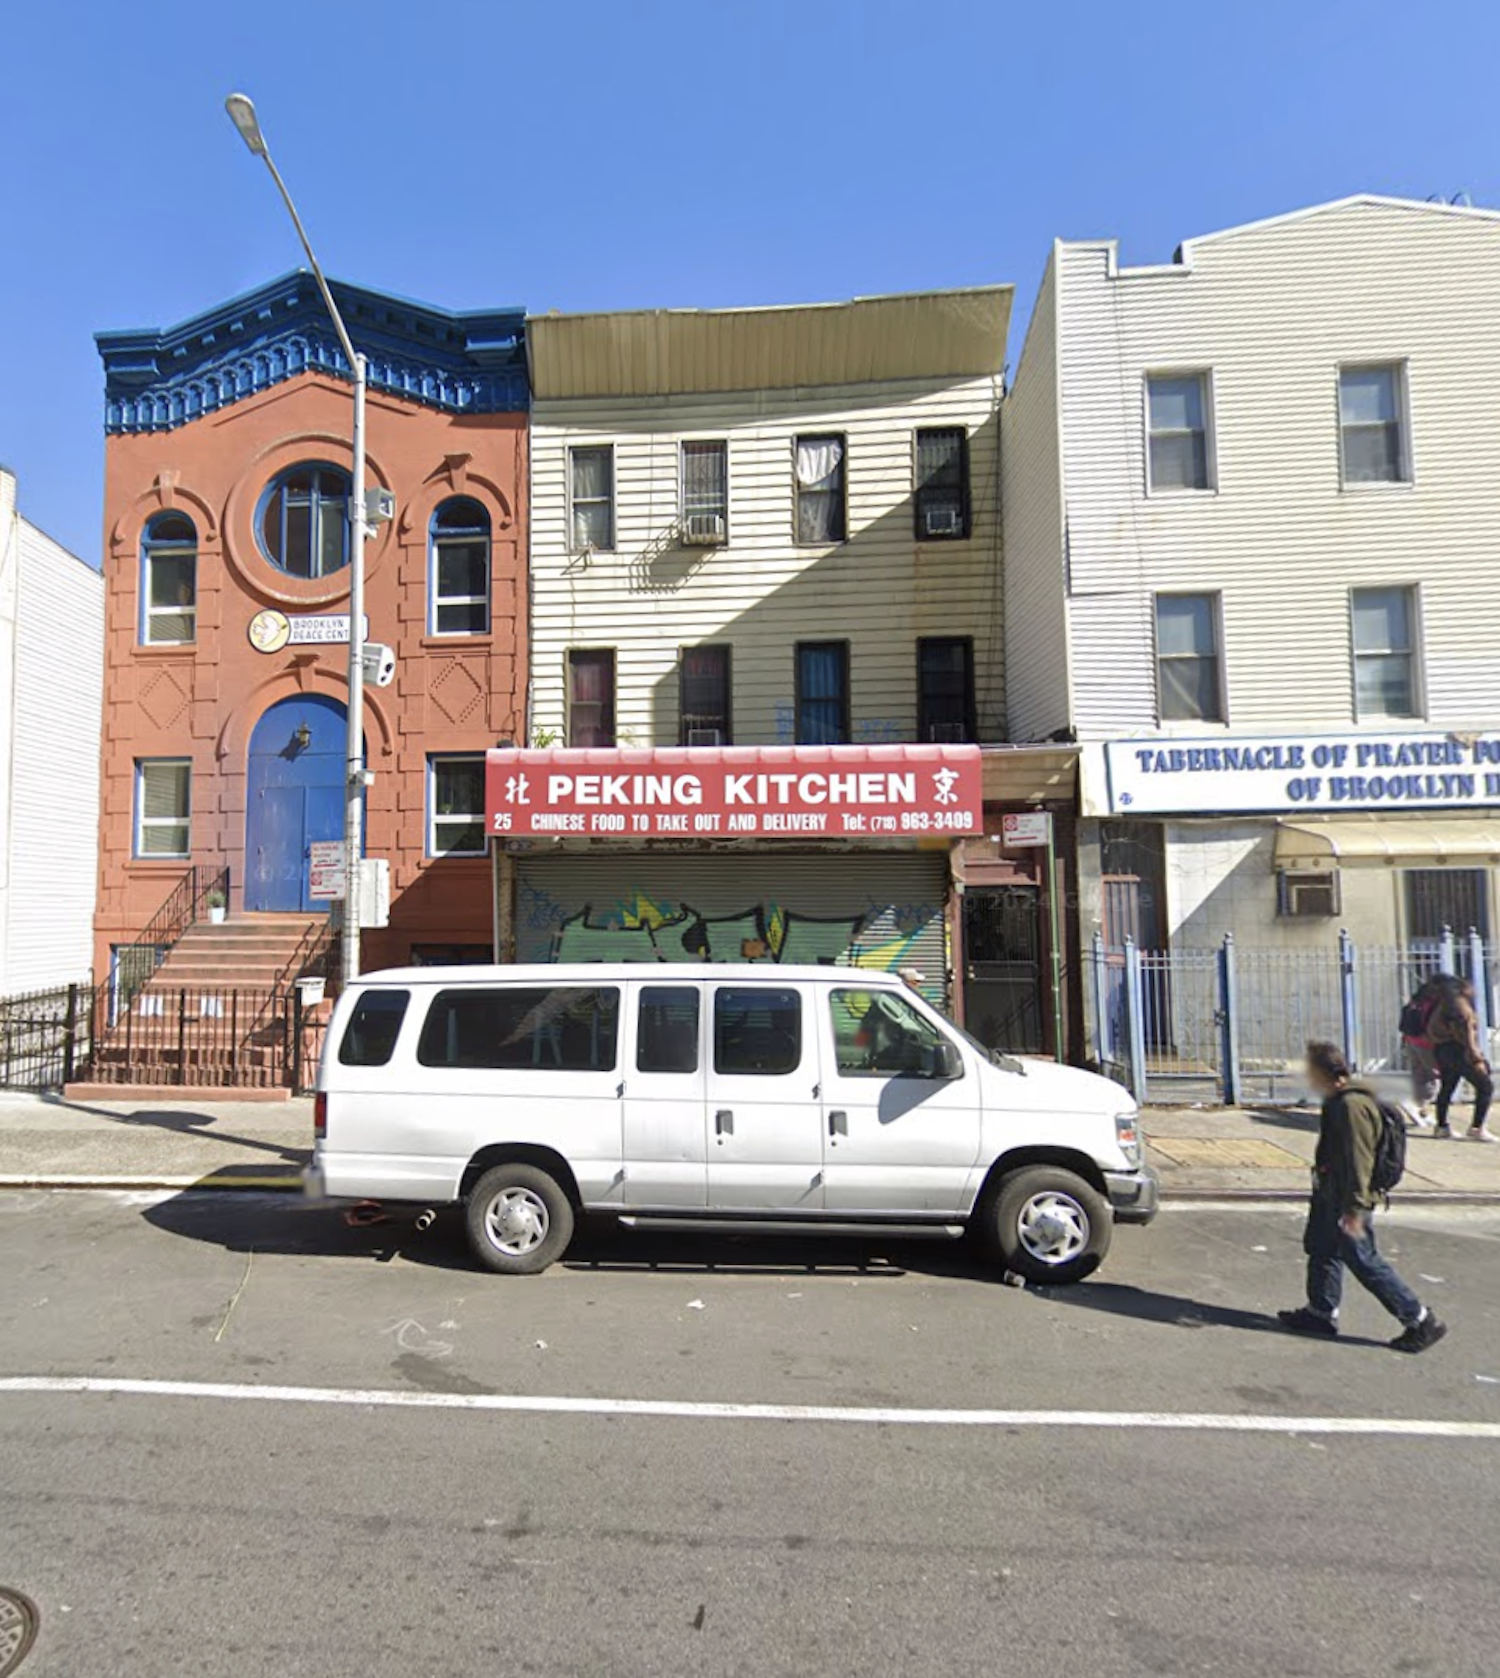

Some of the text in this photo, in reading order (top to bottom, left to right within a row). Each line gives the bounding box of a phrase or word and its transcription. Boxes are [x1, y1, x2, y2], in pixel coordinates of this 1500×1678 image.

[293, 619, 344, 630] BROOKLYN
[293, 630, 348, 640] PEACE CENT
[1135, 745, 1305, 773] TABERNACLE
[1311, 745, 1348, 768] OF
[1356, 742, 1464, 768] PRAYER
[505, 773, 530, 804] 北
[548, 773, 916, 805] PEKING KITCHEN
[932, 767, 959, 805] 京
[1286, 777, 1321, 801] OF
[1328, 774, 1474, 801] BROOKLYN
[494, 813, 511, 830] 25
[531, 811, 973, 832] CHINESE FOOD TO TAKE OUT AND DELIVERY Tel: (718) 963-3409
